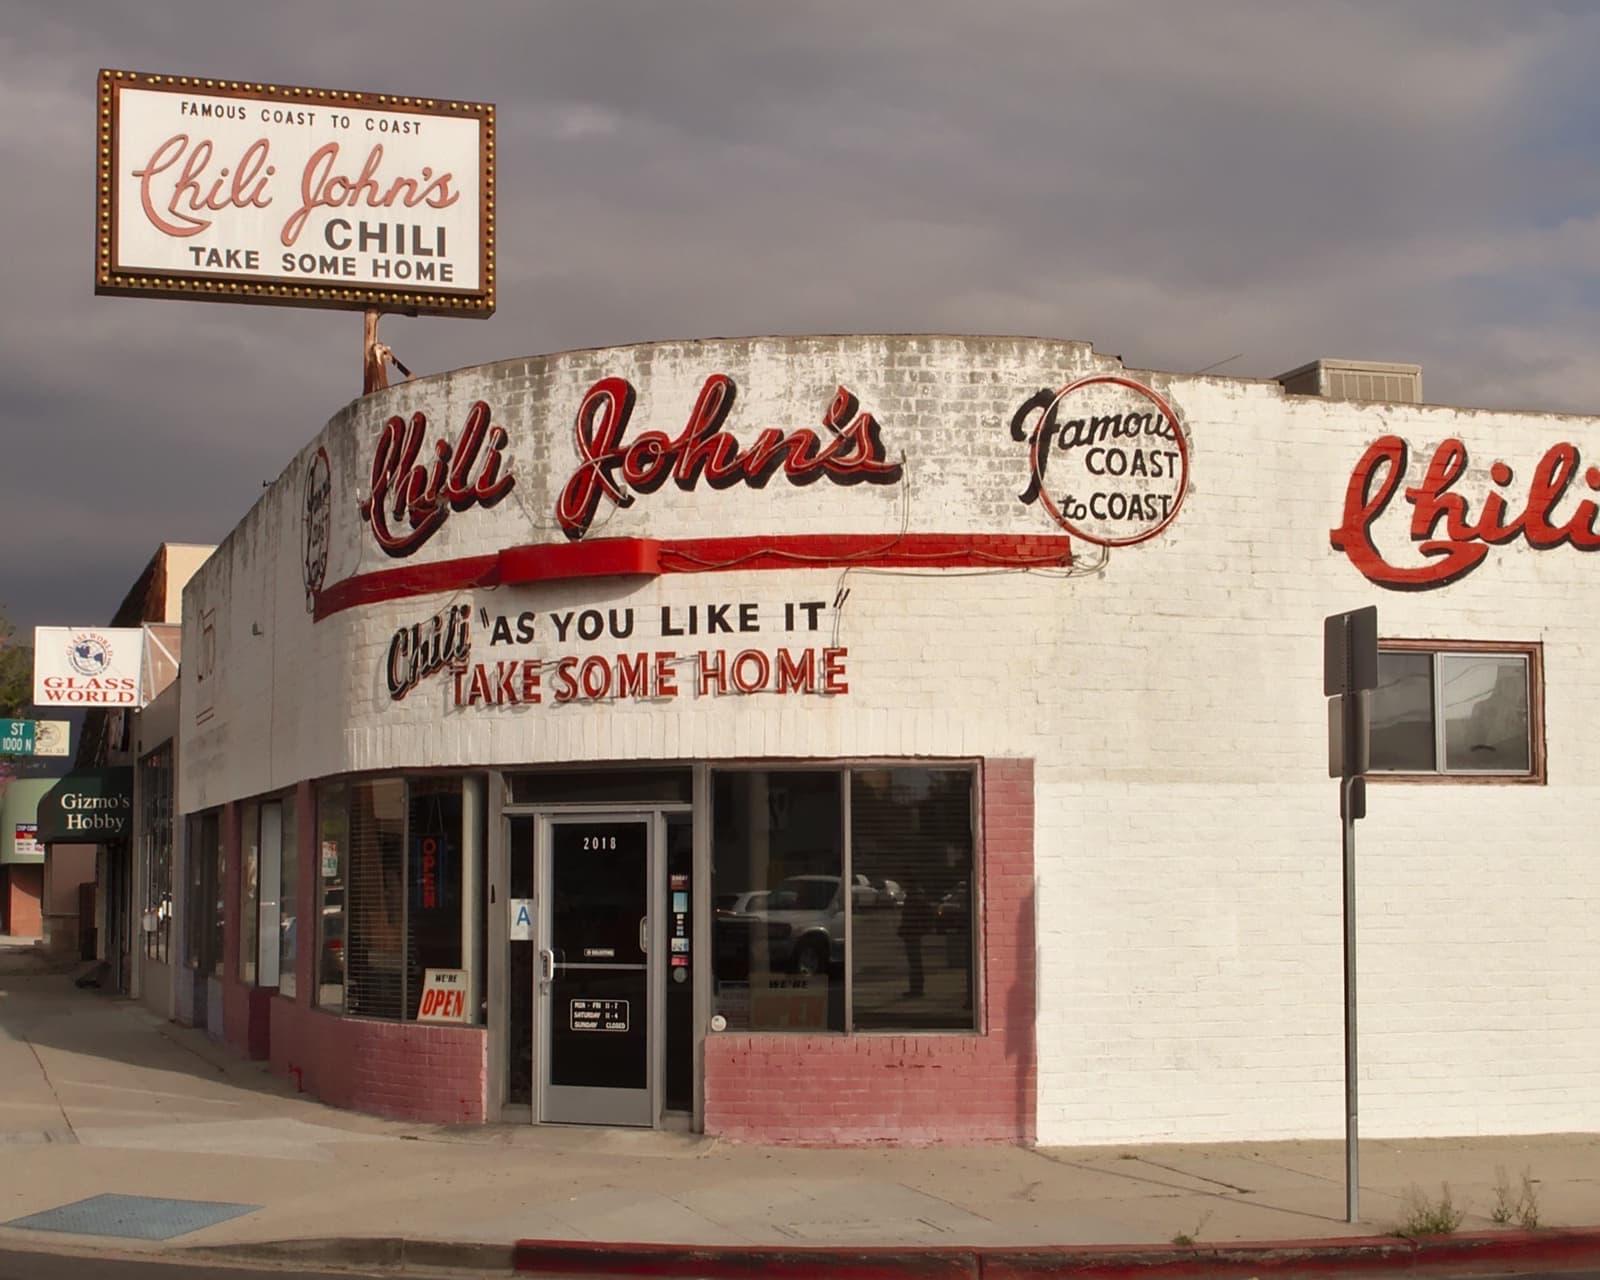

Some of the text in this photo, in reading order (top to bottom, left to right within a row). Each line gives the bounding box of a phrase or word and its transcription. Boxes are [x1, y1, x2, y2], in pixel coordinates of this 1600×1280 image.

[181, 102, 422, 136] FAMOUS COAST TO COAST
[132, 134, 461, 248] Chili John's
[324, 218, 447, 258] CHILI
[189, 246, 455, 283] TAKE SOME HOME
[360, 400, 515, 558] Chili
[556, 373, 904, 541] John's
[1085, 447, 1180, 479] COAST
[1088, 492, 1174, 522] COAST
[386, 603, 472, 701] Chili
[549, 607, 636, 643] YOU
[660, 602, 761, 636] LIKE
[43, 676, 135, 690] GLASS
[452, 646, 849, 707] TAKE SOME HOME
[45, 689, 135, 703] WORLD
[10, 722, 25, 736] ST
[2, 737, 23, 752] 1000
[25, 738, 32, 752] N
[60, 793, 130, 810] Gizmo's
[66, 813, 125, 833] Hobby
[583, 836, 617, 850] 2018
[516, 905, 531, 926] A
[422, 988, 466, 1017] OPEN
